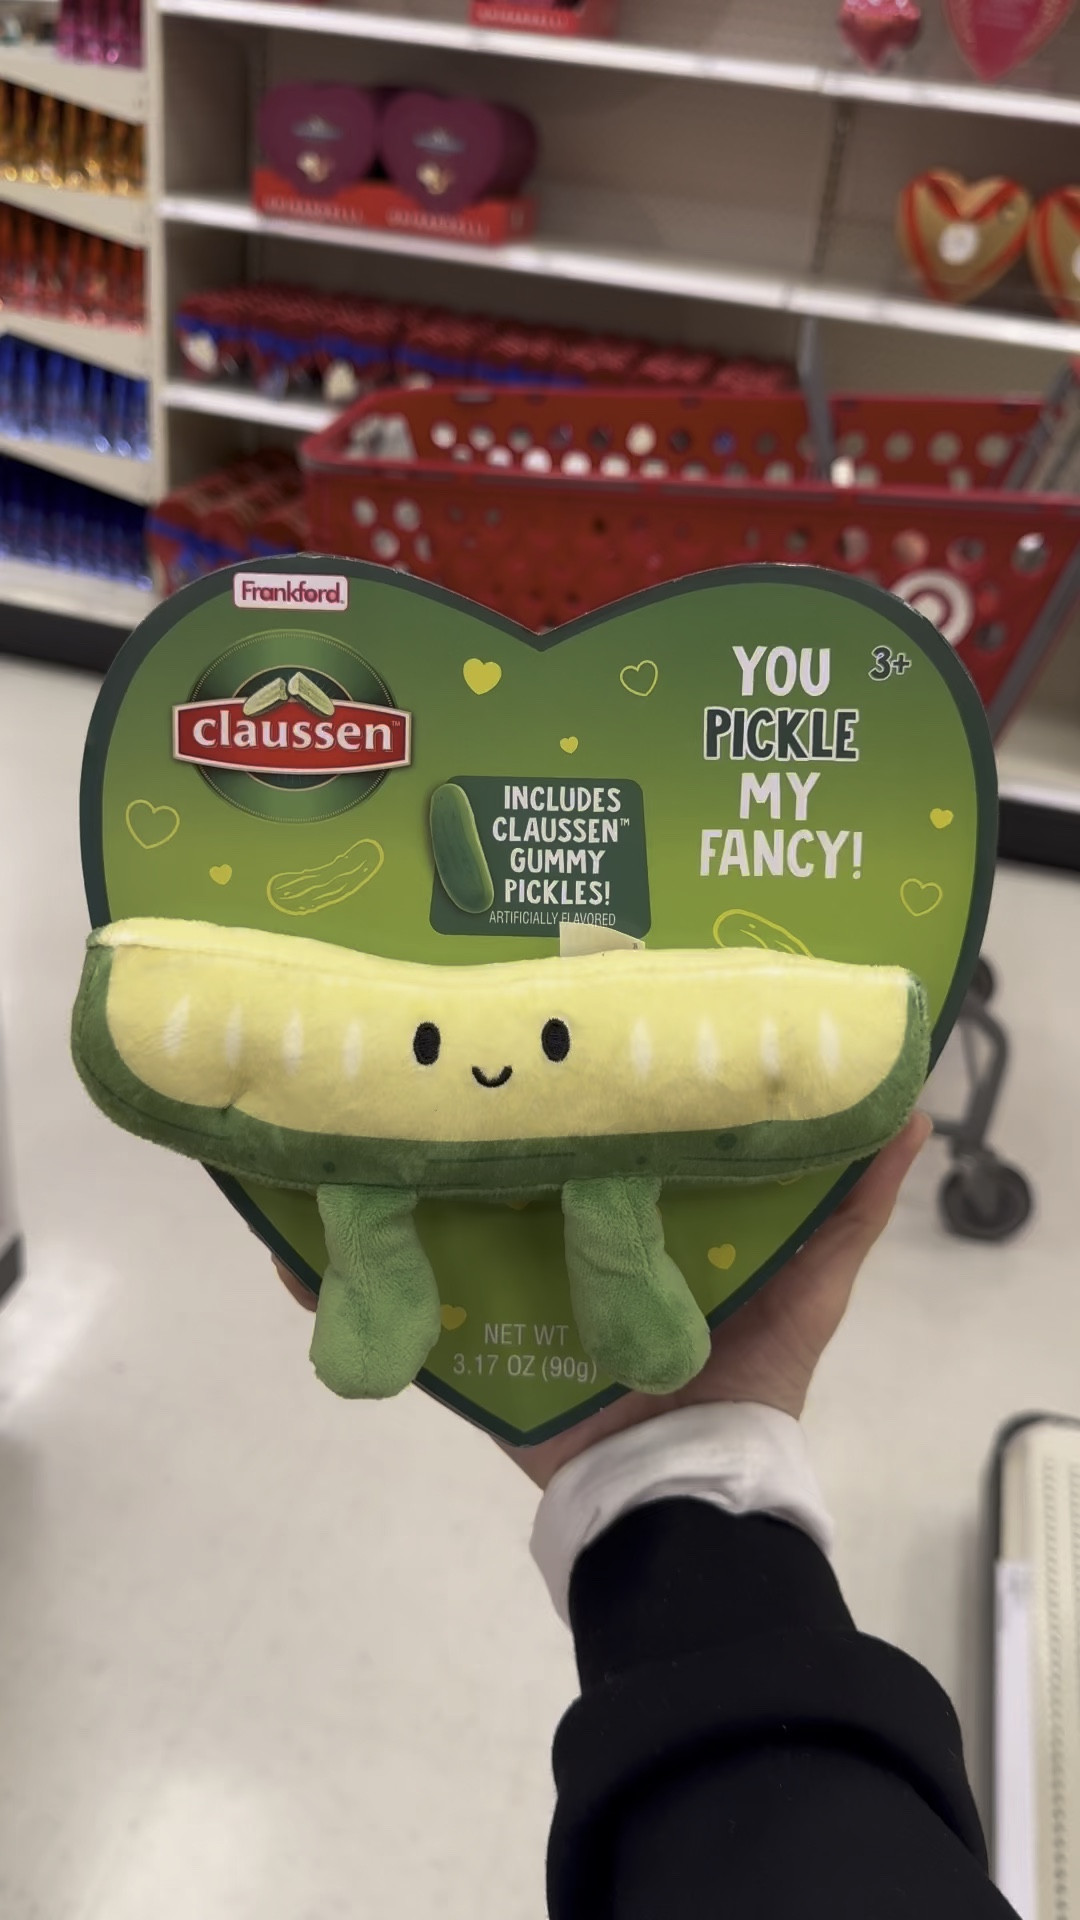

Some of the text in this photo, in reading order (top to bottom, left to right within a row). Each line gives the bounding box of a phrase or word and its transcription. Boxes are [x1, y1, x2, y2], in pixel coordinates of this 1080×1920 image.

[242, 580, 340, 604] Frankford
[732, 645, 830, 696] YOU
[868, 645, 912, 681] 3+
[704, 706, 859, 761] PICKLE
[504, 785, 621, 813] INCLUDES
[740, 772, 821, 820] MY
[510, 848, 606, 874] GUMMY
[700, 829, 863, 880] FANCY!
[504, 879, 611, 906] PICKLES!
[489, 911, 616, 928] ARTIFICIALLY FLAVORED
[484, 1323, 569, 1346] NET WT
[453, 1353, 597, 1384] 3.17 OZ (90g)
